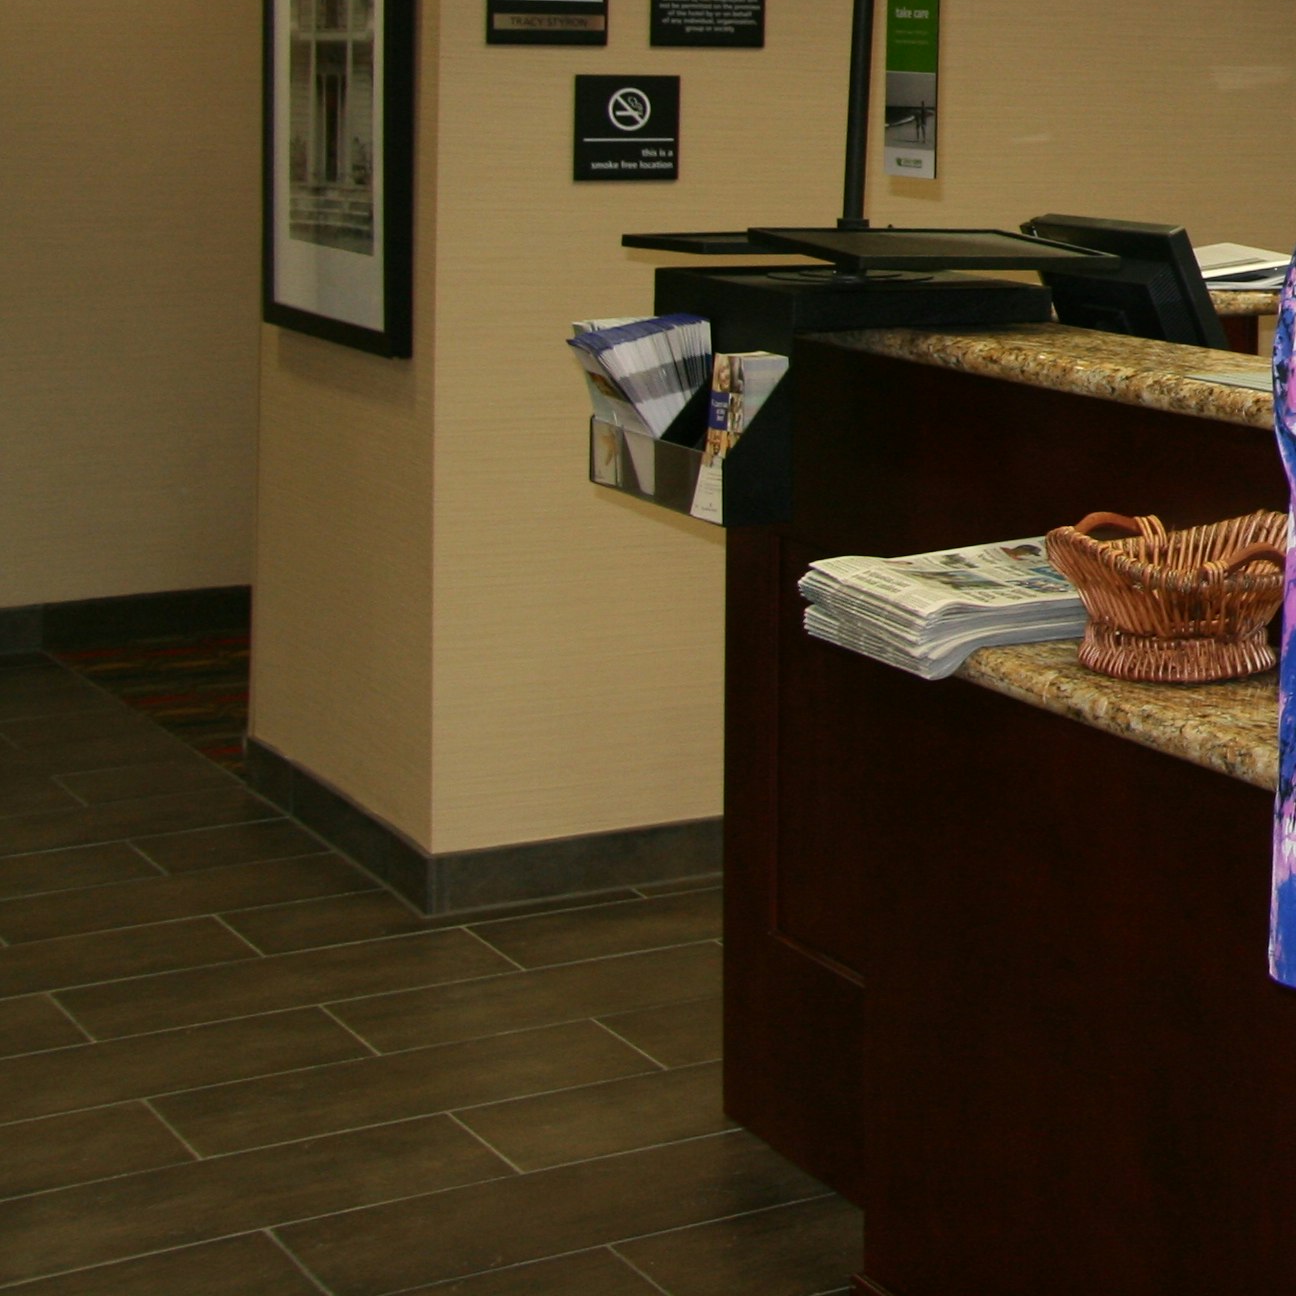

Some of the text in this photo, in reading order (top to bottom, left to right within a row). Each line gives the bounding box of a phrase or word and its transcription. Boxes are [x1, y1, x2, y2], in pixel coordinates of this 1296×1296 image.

[641, 148, 657, 157] this
[591, 159, 674, 170] smoke free location
